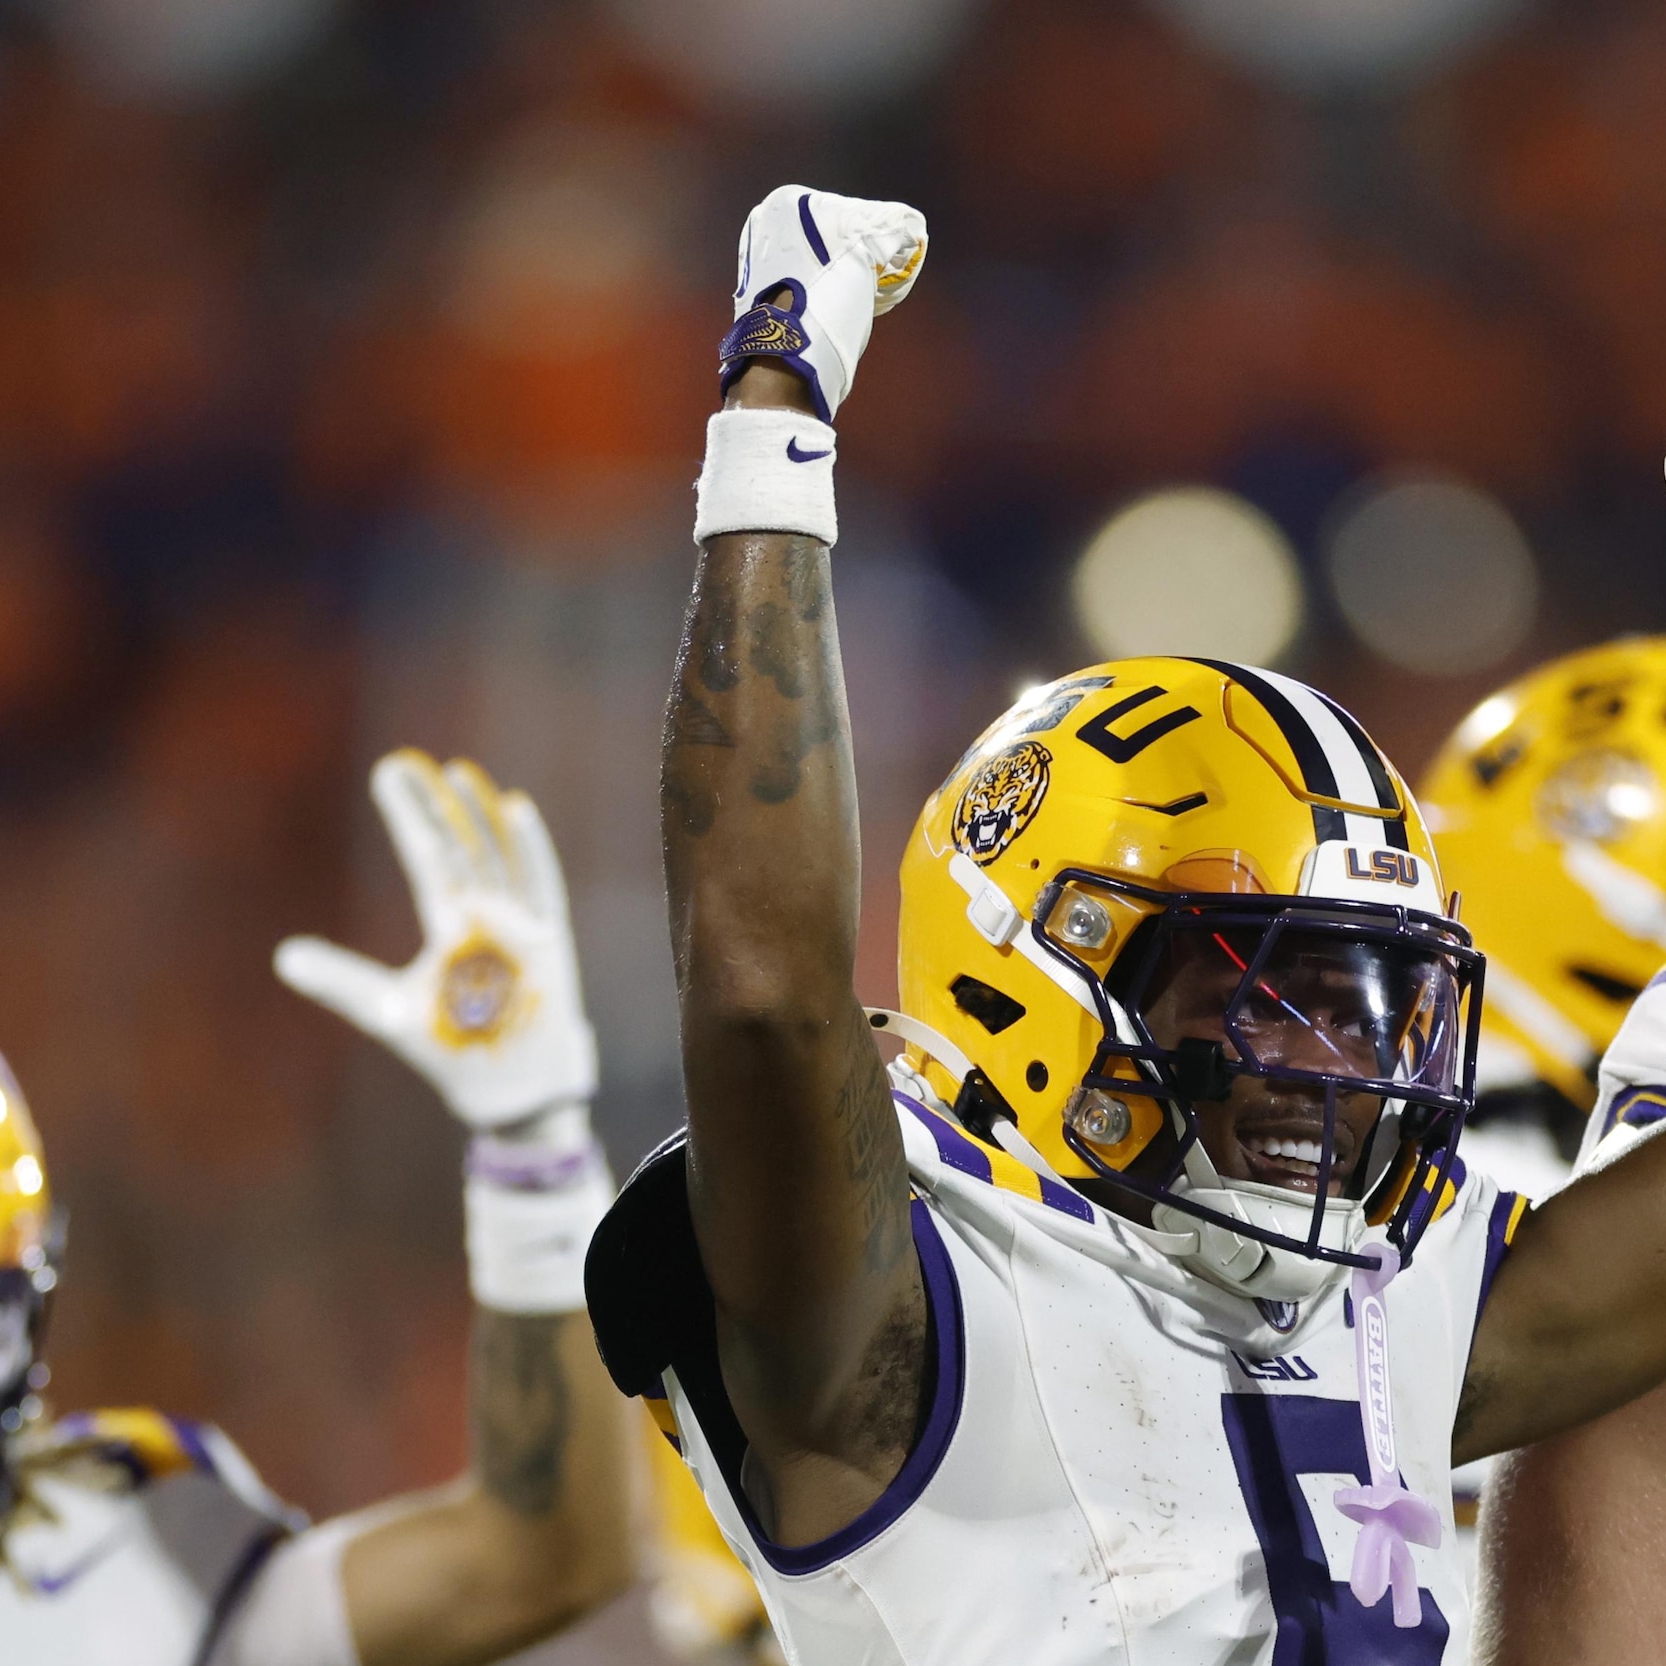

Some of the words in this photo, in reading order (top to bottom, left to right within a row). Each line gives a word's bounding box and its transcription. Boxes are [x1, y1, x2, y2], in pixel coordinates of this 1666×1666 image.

[1344, 847, 1419, 888] LSU
[1230, 1350, 1318, 1381] LSU
[1366, 1311, 1391, 1458] BATTLE
